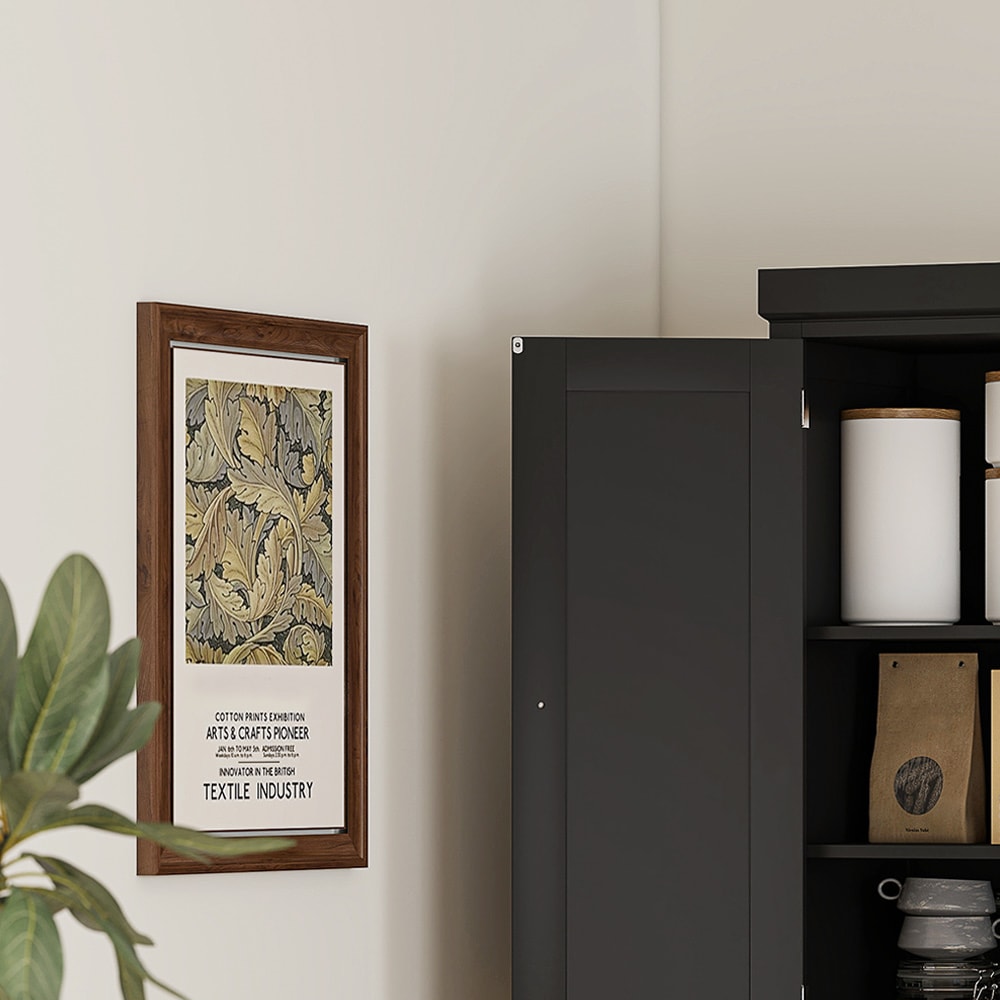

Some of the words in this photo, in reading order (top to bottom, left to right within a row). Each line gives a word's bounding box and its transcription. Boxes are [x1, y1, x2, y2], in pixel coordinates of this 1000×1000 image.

[215, 712, 244, 722] COTTON
[245, 712, 268, 722] PRINTS
[269, 712, 305, 722] EXHIBITION
[206, 726, 229, 740] ARTS
[230, 727, 236, 740] &
[238, 726, 272, 740] CRAFTS
[274, 726, 310, 740] PIONEER
[220, 767, 254, 776] INNOVATOR
[255, 767, 261, 776] IN
[262, 767, 274, 776] THE
[274, 766, 296, 776] BRITISH
[204, 782, 250, 800] TEXTILE
[256, 782, 313, 800] INDUSTRY
